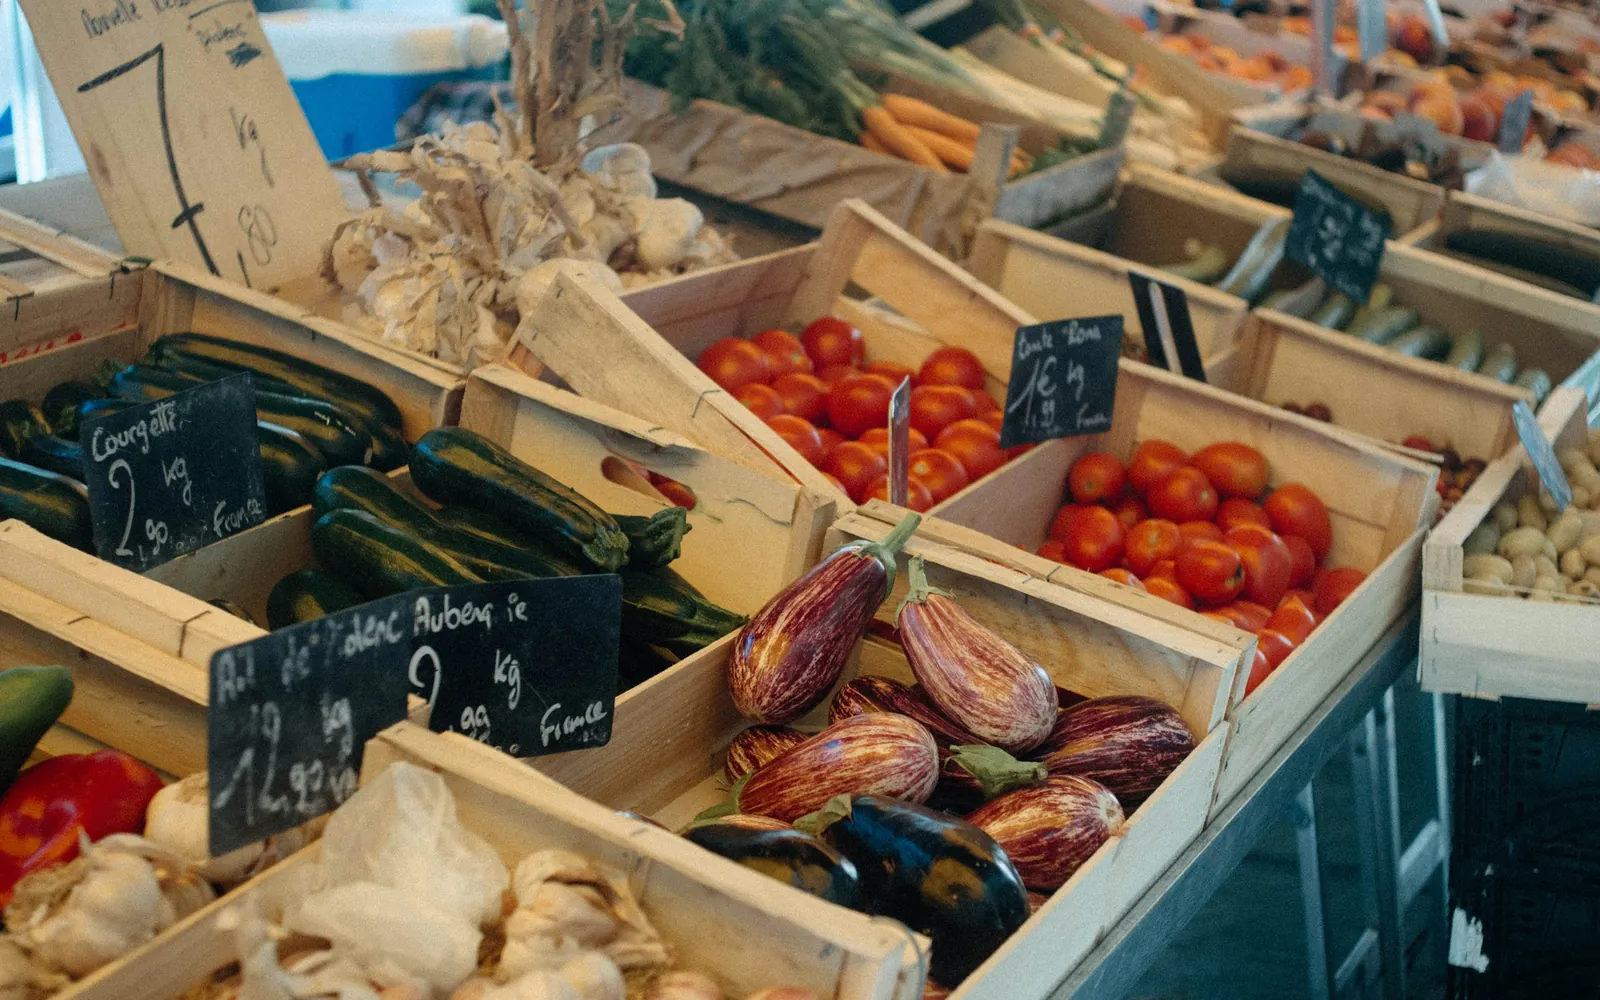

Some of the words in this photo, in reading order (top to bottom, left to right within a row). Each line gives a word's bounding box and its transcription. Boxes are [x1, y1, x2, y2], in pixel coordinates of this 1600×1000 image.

[161, 455, 193, 506] kg
[493, 649, 521, 711] kg
[540, 702, 608, 748] France
